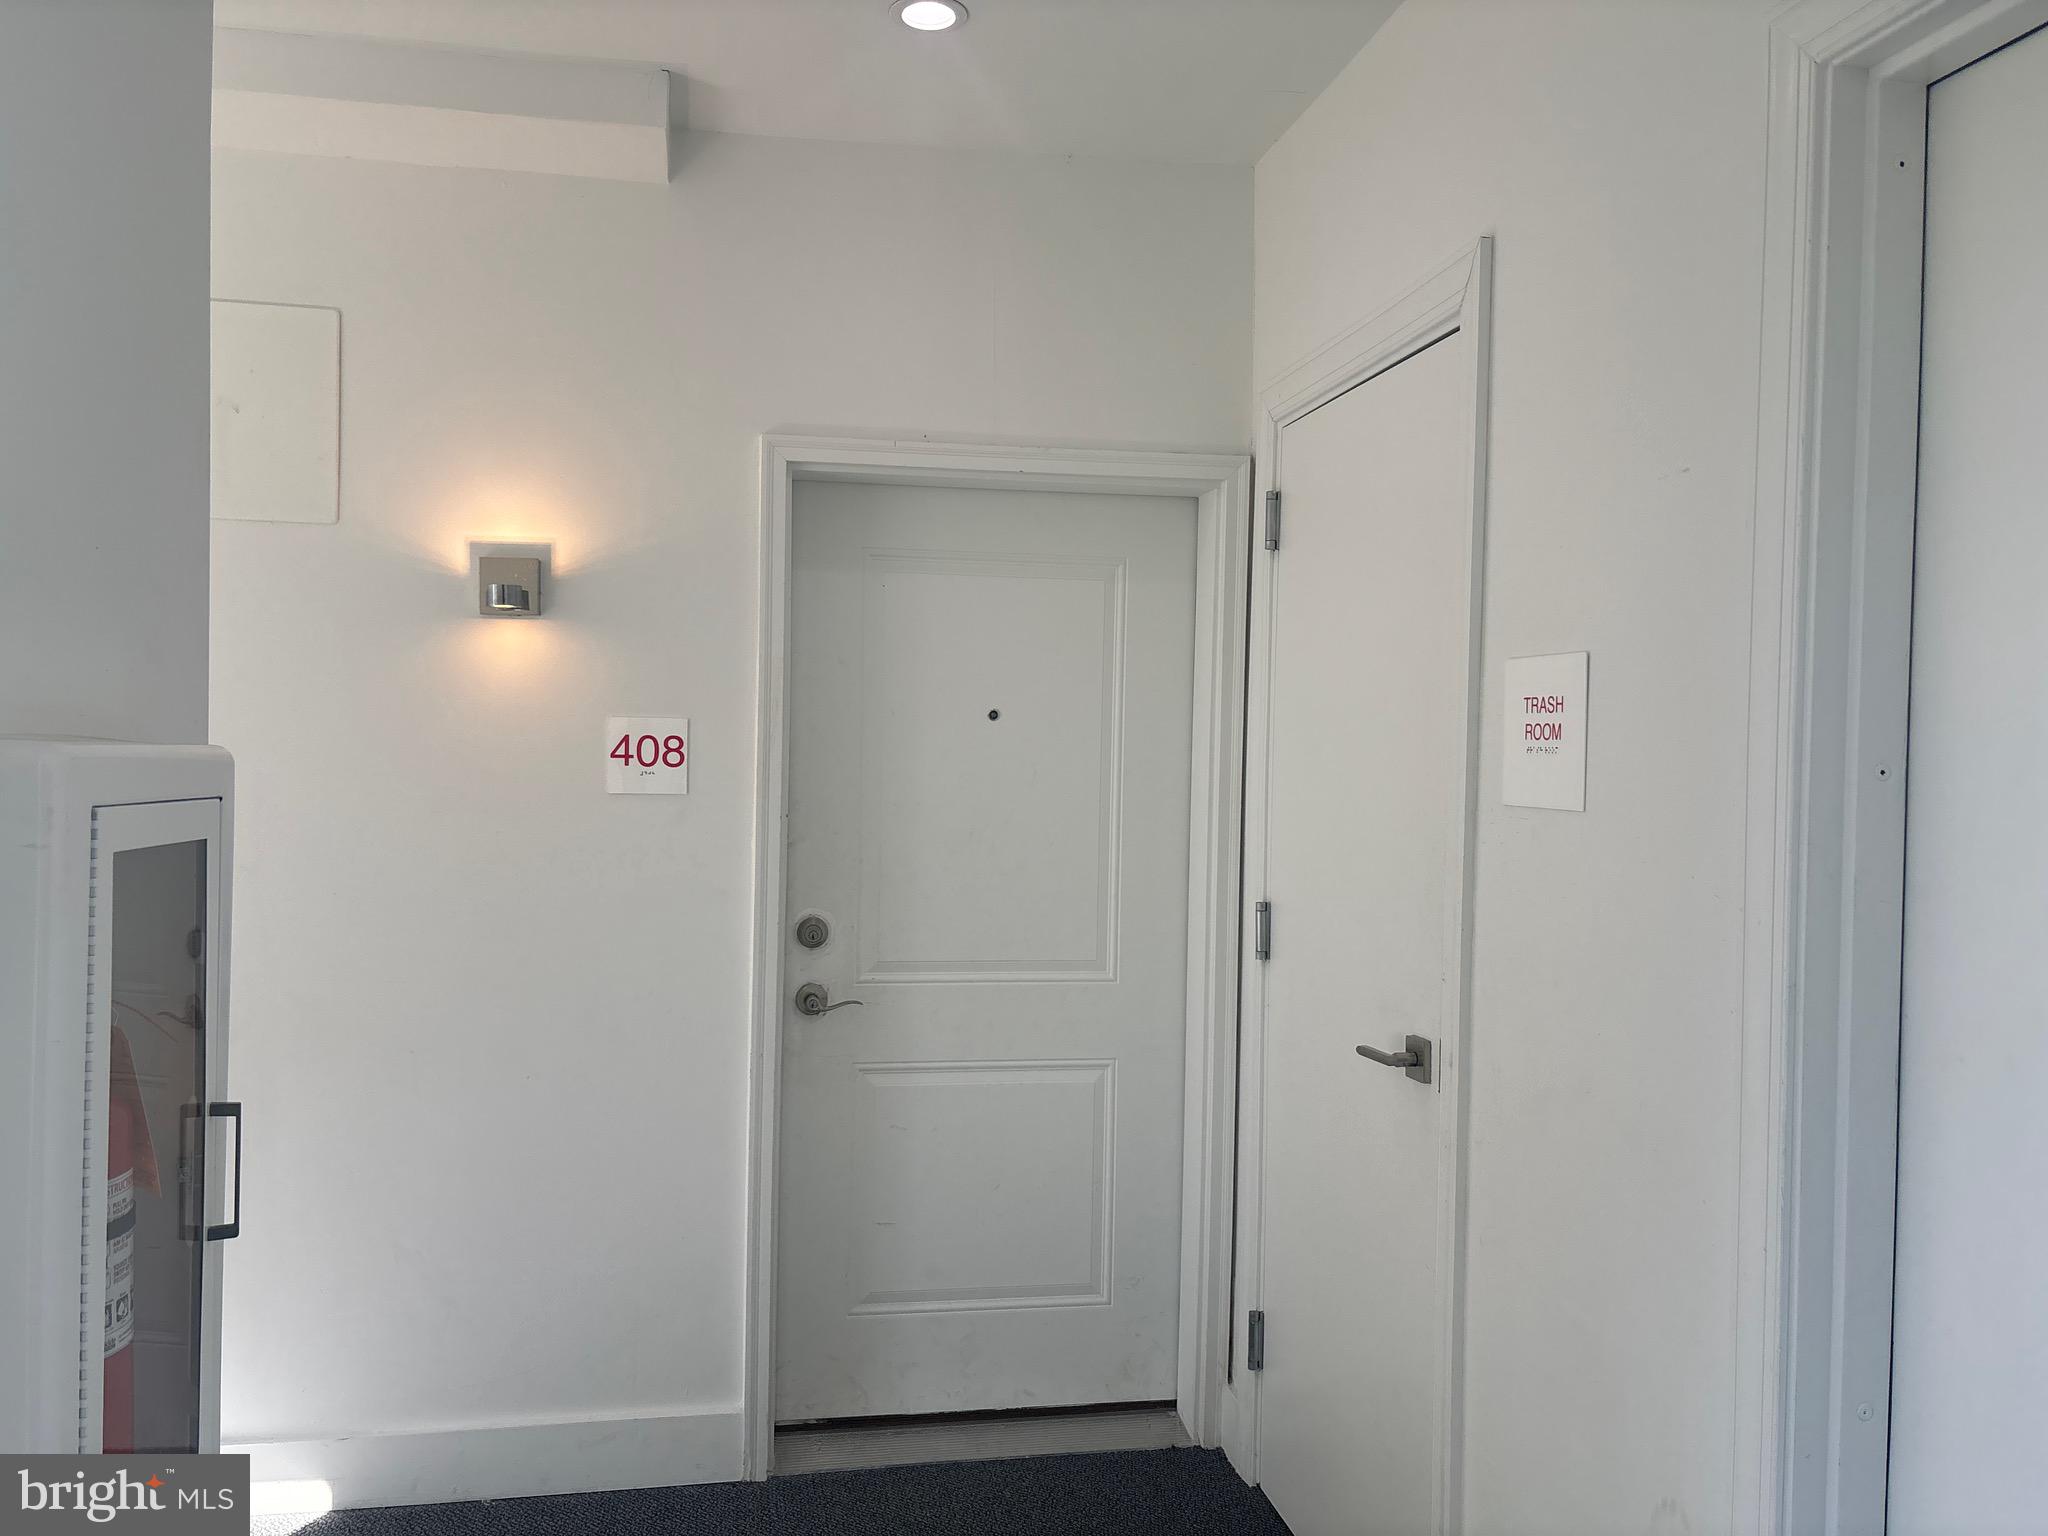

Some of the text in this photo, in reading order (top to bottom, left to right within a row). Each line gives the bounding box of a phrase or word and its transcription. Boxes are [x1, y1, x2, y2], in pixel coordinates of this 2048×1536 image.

[1523, 696, 1564, 714] TRASH
[1524, 723, 1562, 741] ROOM
[610, 734, 685, 768] 408
